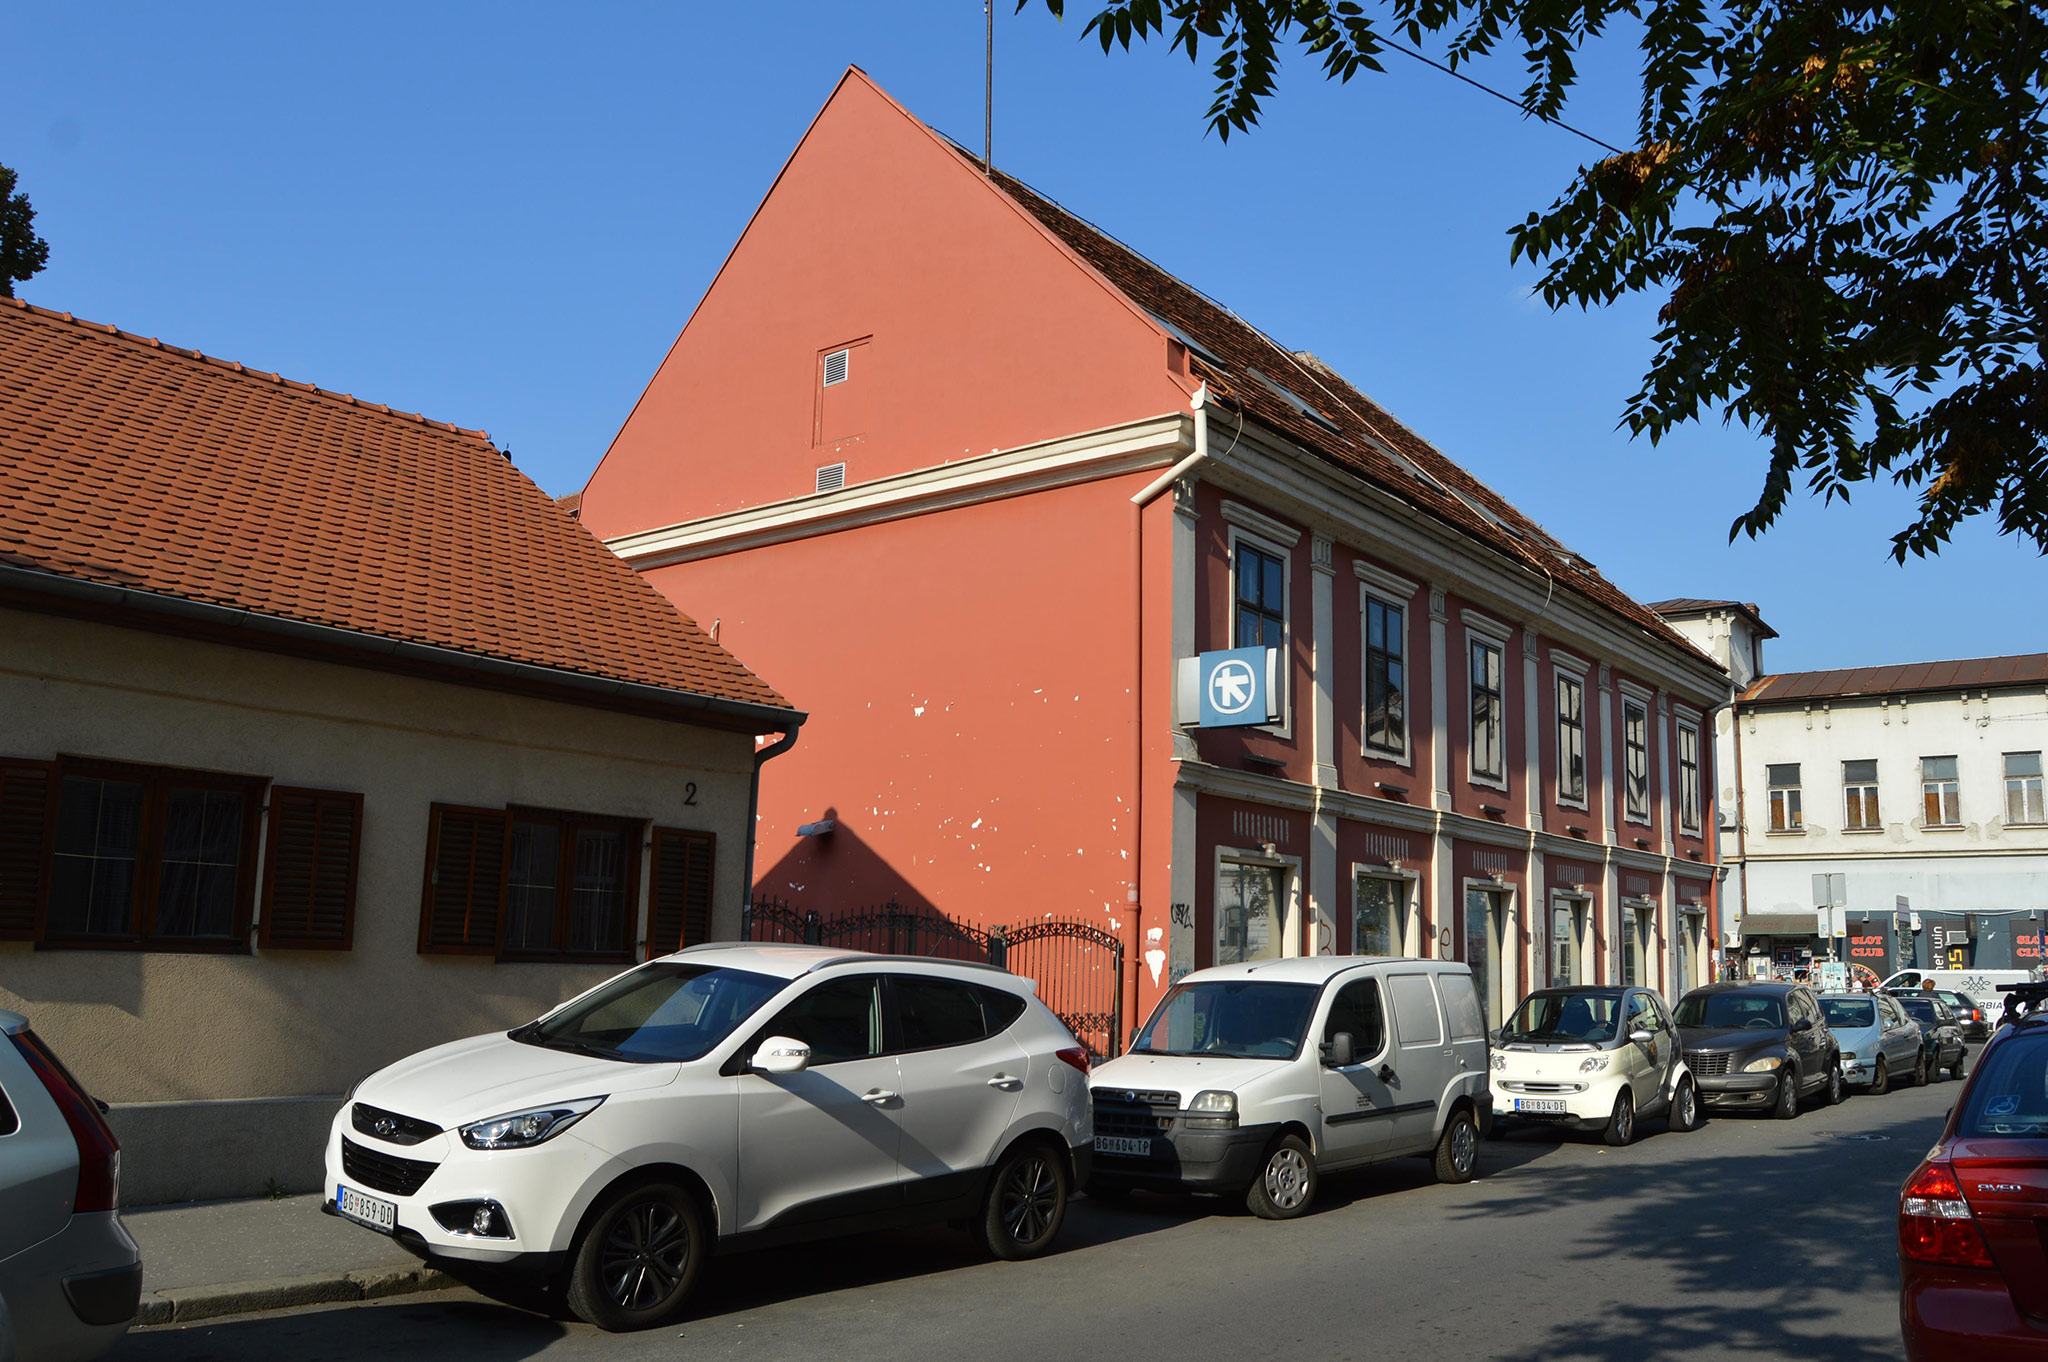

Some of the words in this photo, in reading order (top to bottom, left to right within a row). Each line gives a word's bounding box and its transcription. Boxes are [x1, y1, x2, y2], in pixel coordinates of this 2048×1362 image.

[683, 782, 698, 806] 2
[1851, 936, 1883, 945] SLOT
[1931, 926, 1944, 949] win
[1851, 947, 1884, 957] CLUB
[2016, 947, 2048, 957] CLU
[1977, 1183, 2022, 1194] AVEO
